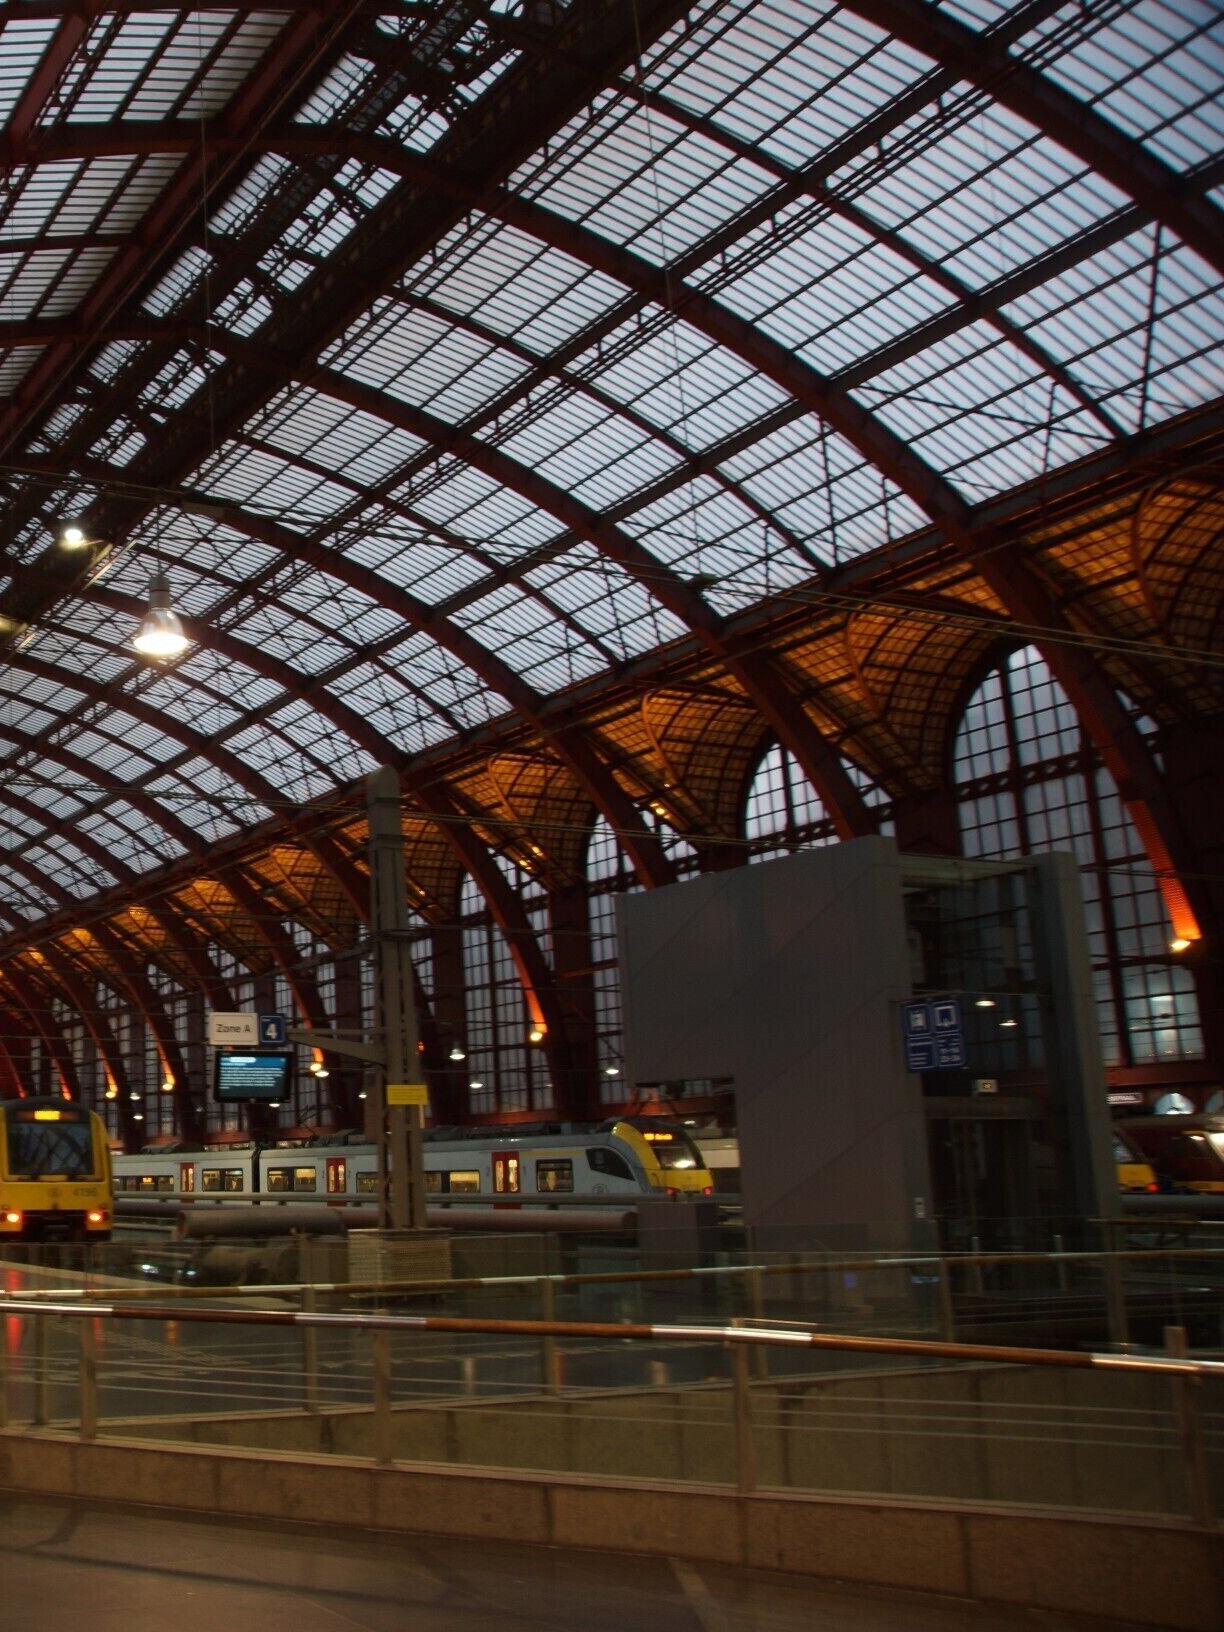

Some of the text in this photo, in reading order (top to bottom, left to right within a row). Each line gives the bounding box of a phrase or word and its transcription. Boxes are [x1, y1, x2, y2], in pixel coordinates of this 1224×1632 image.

[216, 1023, 252, 1033] Zone A
[264, 1022, 279, 1040] 4
